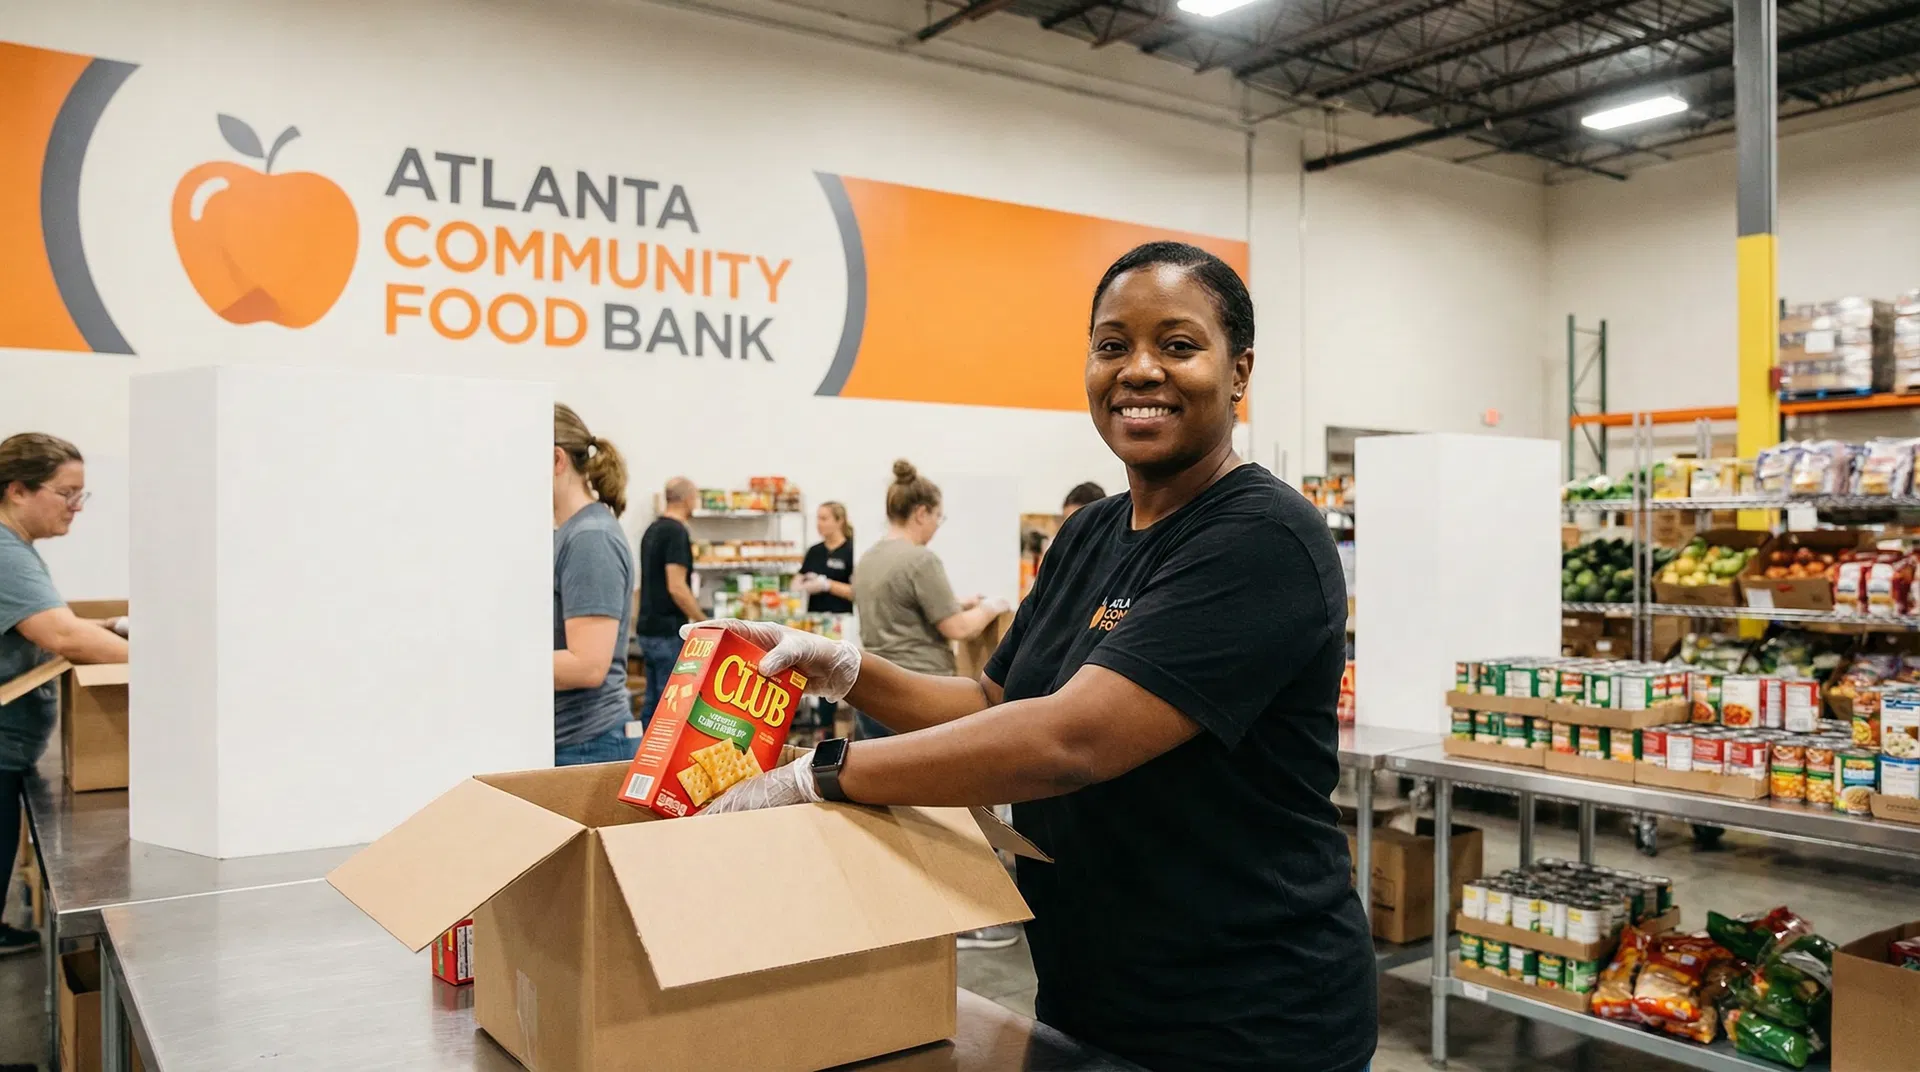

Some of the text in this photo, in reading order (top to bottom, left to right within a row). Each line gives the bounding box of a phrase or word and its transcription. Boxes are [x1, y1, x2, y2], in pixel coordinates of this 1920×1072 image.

[385, 147, 699, 233] ATLANTA
[385, 215, 792, 303] COMMUNITY
[385, 284, 774, 362] FOOD BANK
[714, 654, 790, 727] CLUB
